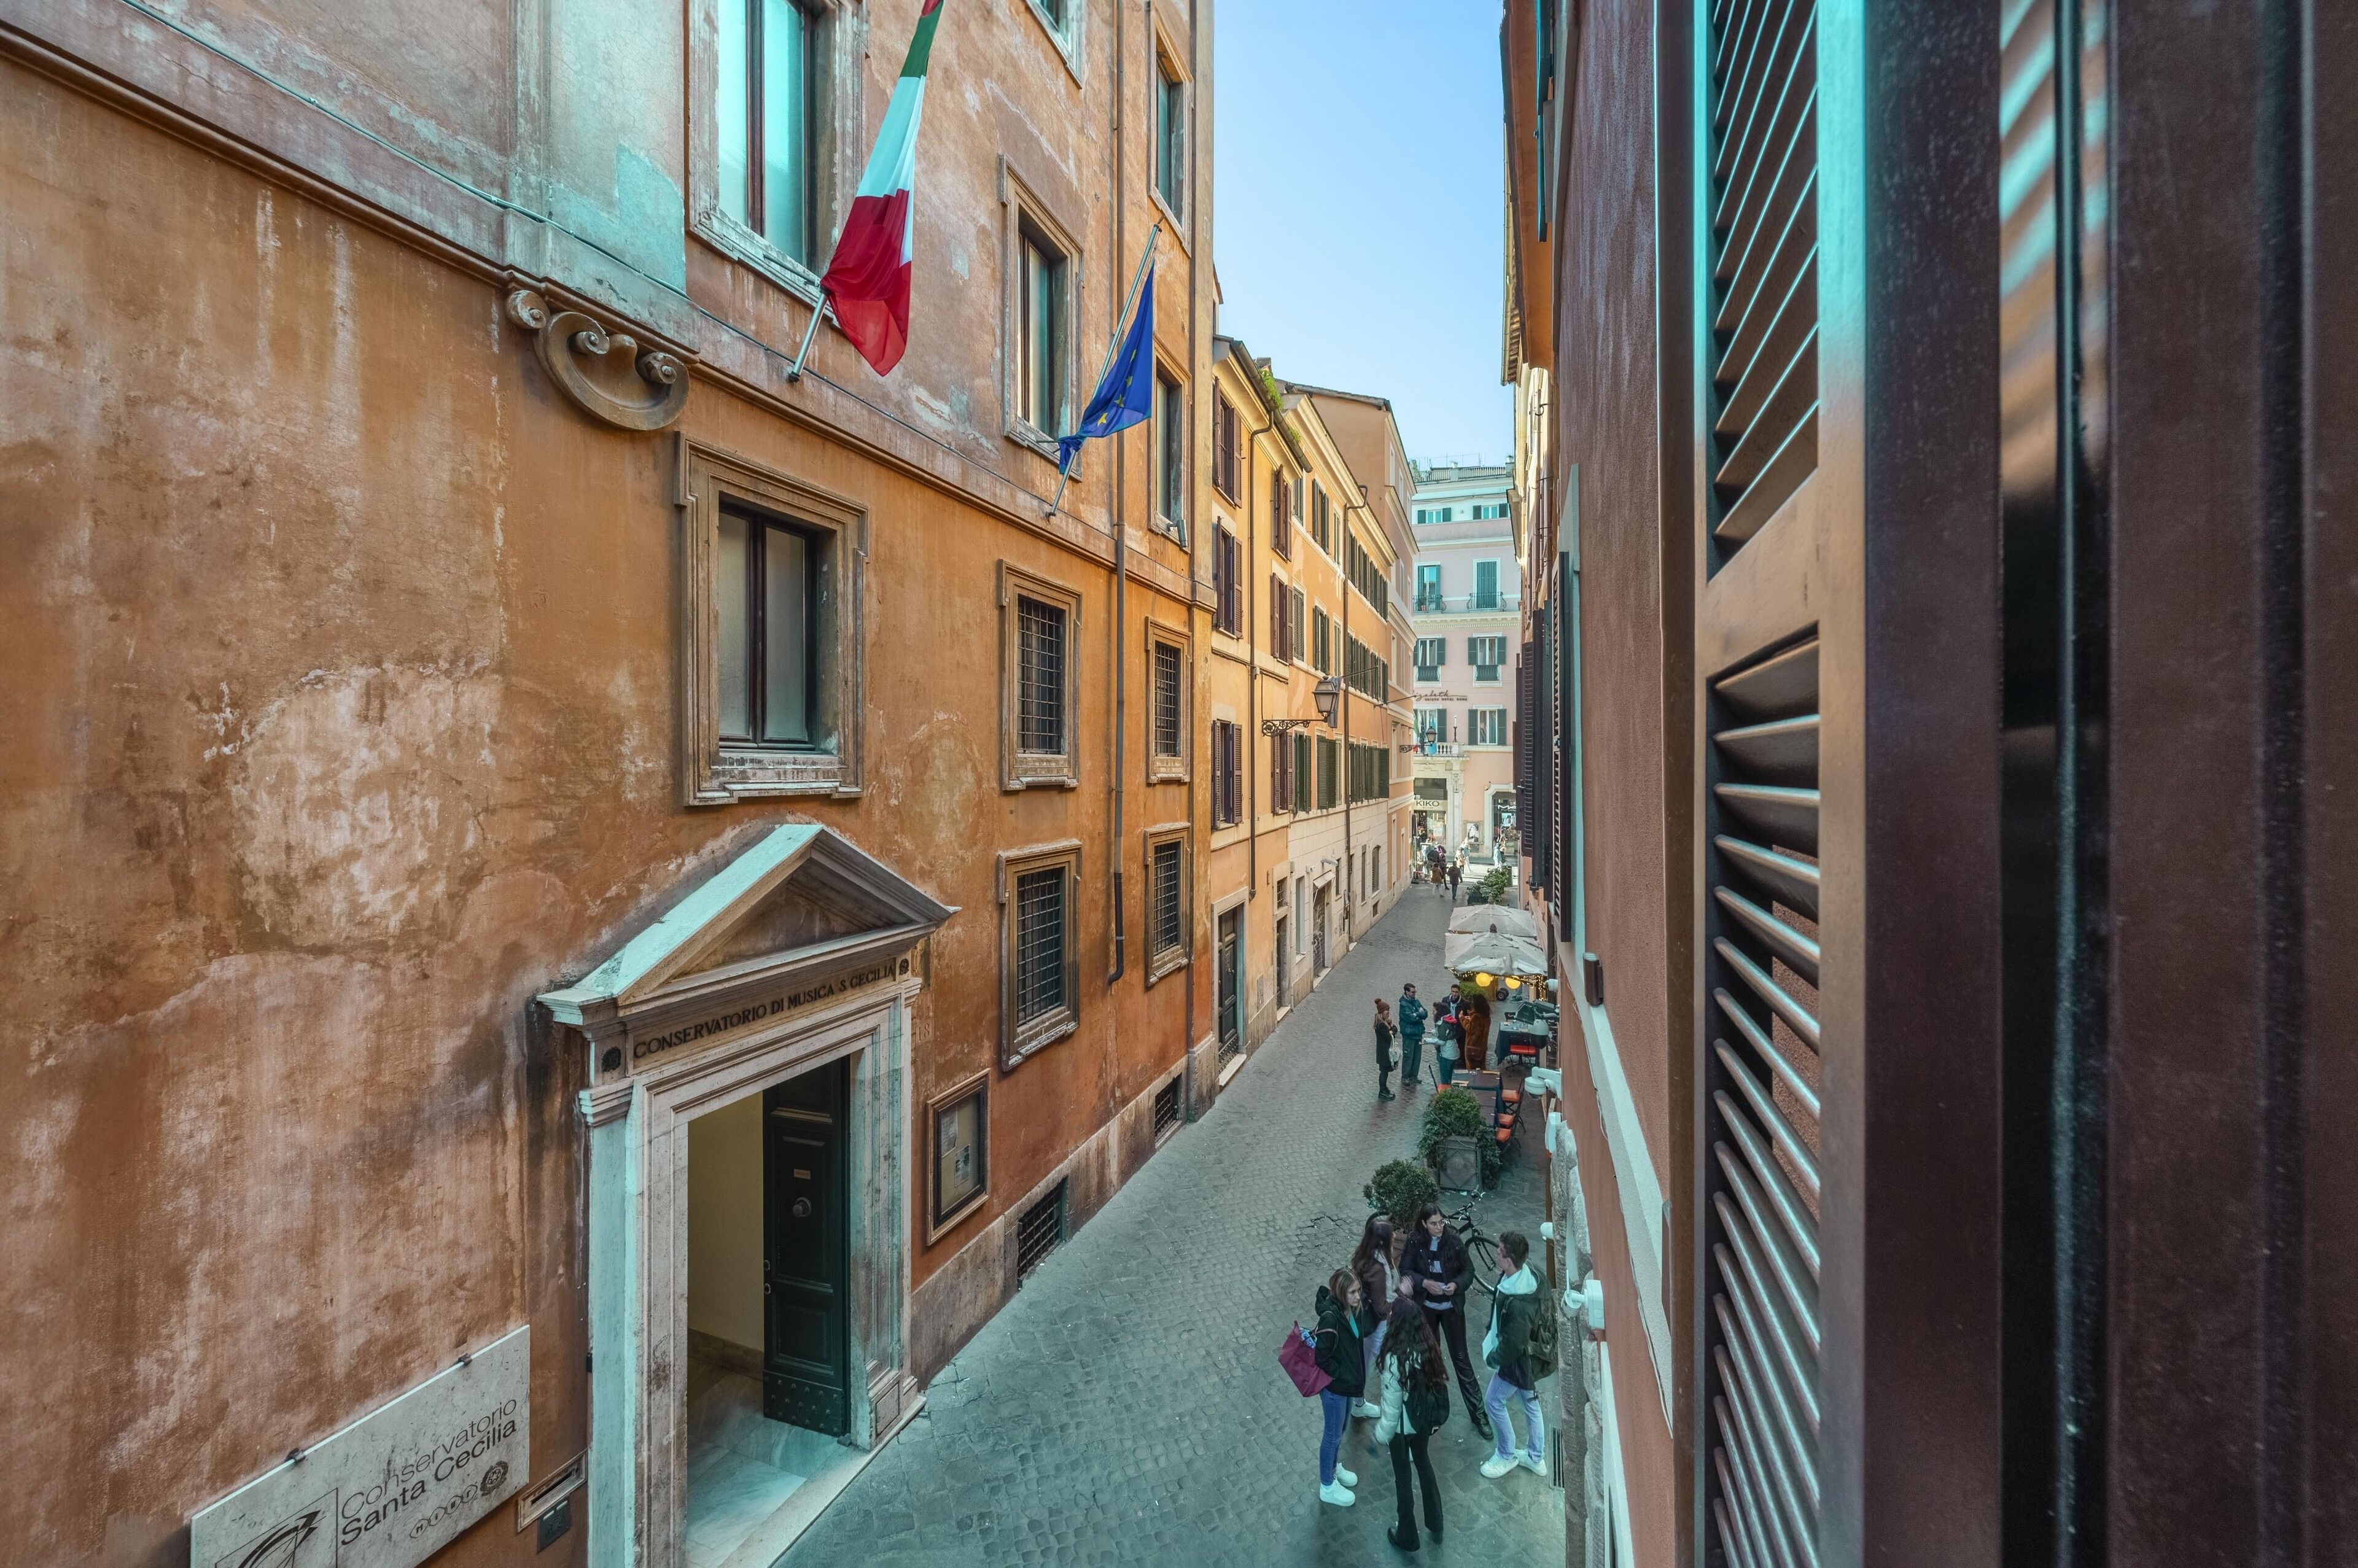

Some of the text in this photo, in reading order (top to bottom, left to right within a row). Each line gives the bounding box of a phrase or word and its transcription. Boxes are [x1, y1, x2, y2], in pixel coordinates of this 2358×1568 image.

[633, 1004, 767, 1058] CONSERVATORIO
[771, 997, 784, 1015] DI
[787, 984, 835, 1010] MUSICA
[850, 964, 894, 988] CECILIA
[919, 1023, 930, 1041] 18
[341, 1399, 517, 1519] Conservatorio
[341, 1419, 516, 1546] Santa Cecilia
